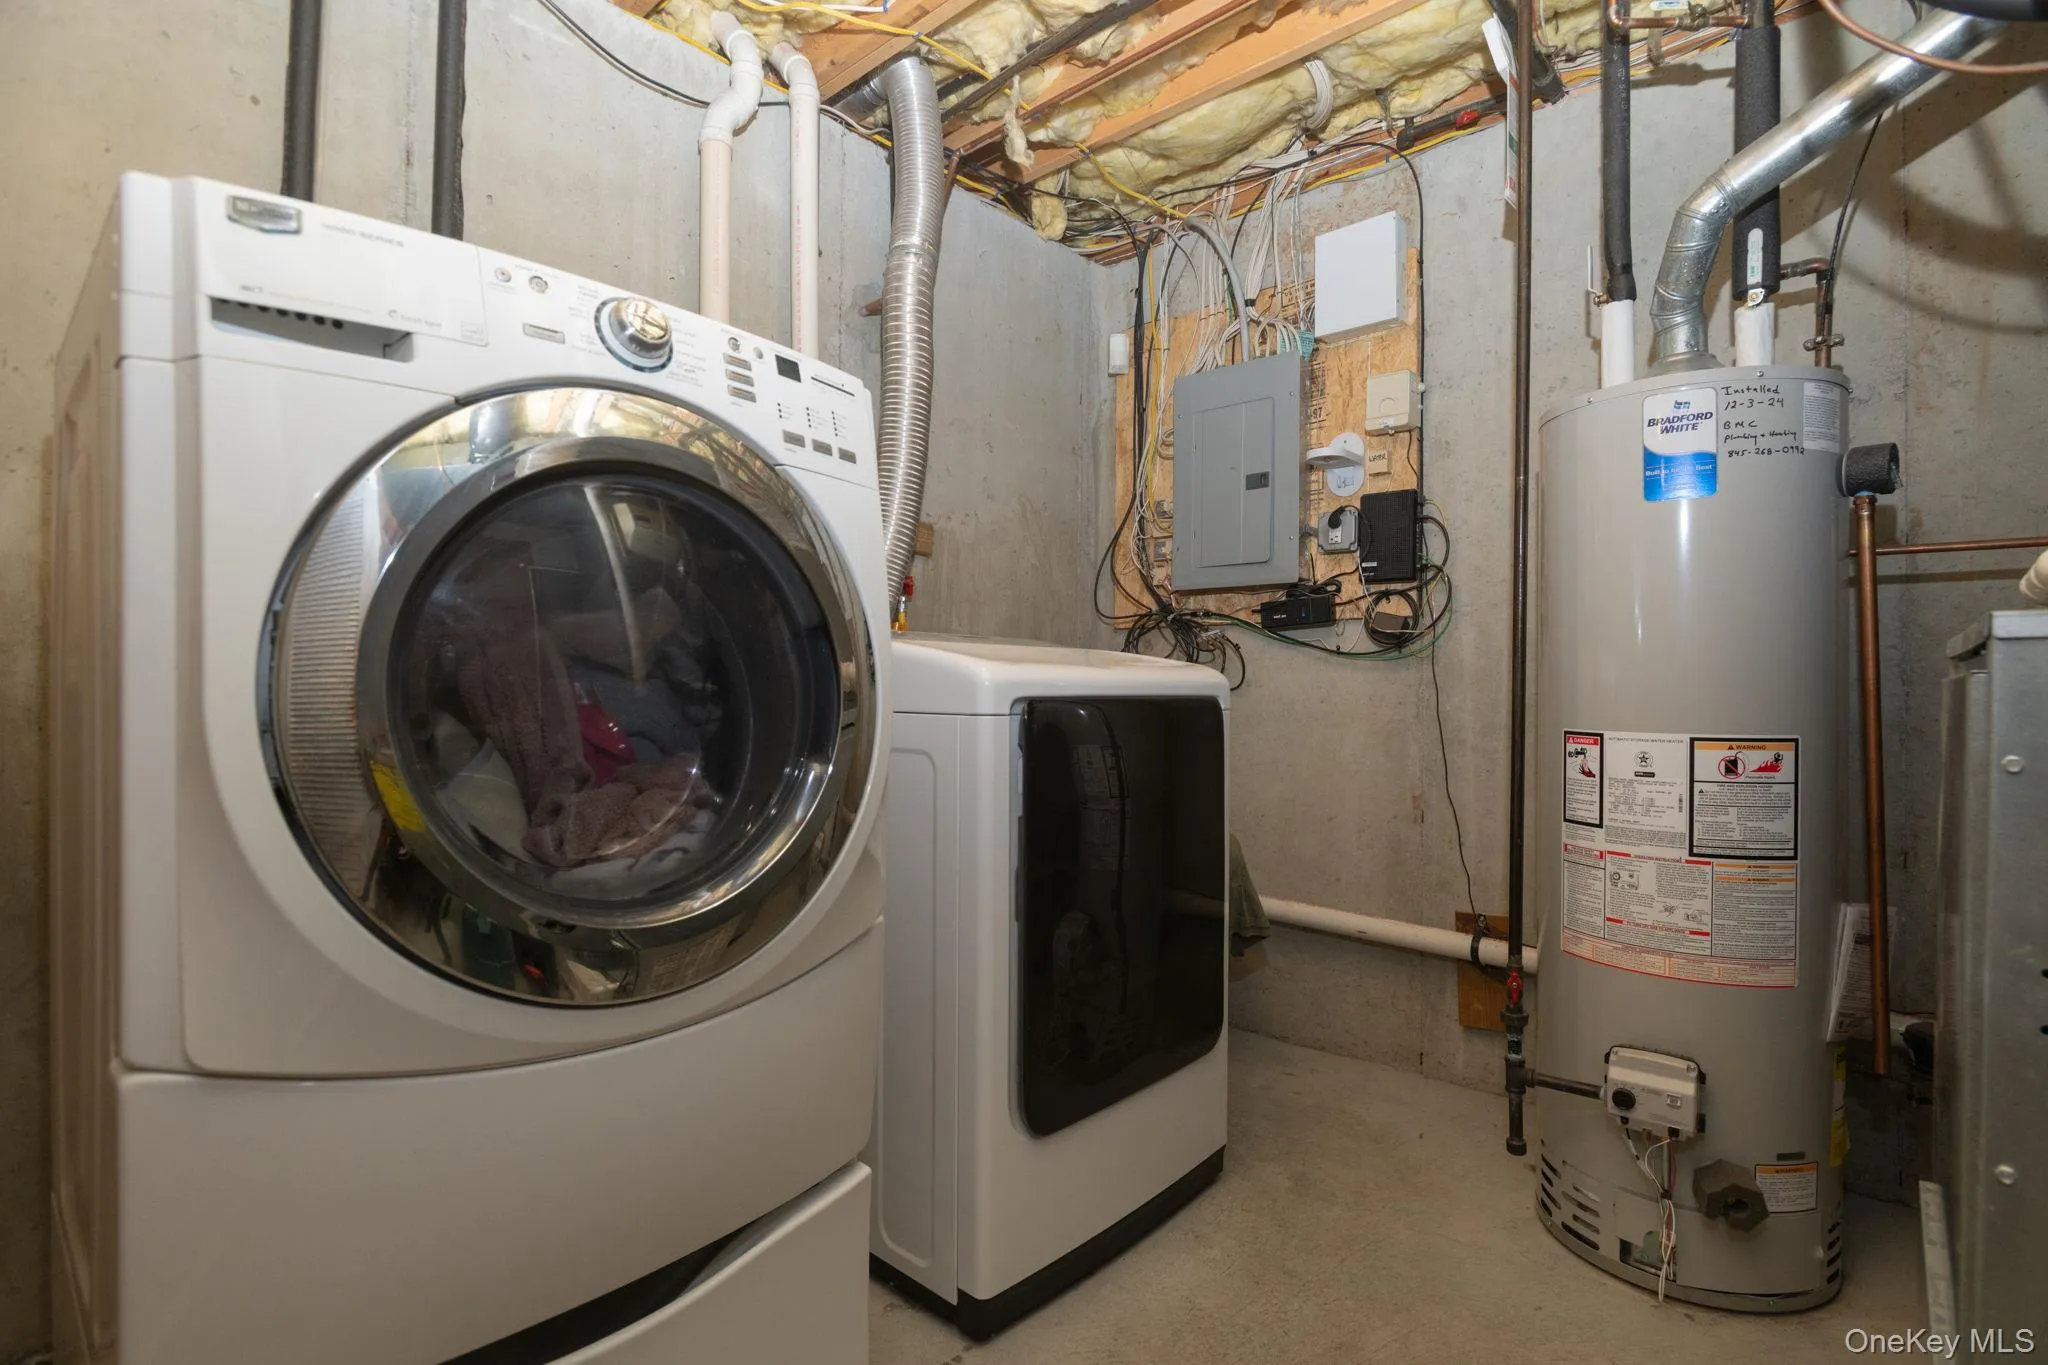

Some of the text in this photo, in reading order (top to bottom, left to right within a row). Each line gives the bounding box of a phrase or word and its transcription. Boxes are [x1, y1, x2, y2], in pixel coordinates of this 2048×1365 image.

[1721, 385, 1780, 396] Installed
[1724, 398, 1784, 411] 12-3-24
[1647, 411, 1713, 428] BRADFORD
[1660, 421, 1699, 434] WHITE
[1727, 445, 1805, 458] 845-268-0992
[1573, 736, 1594, 744] DANGER
